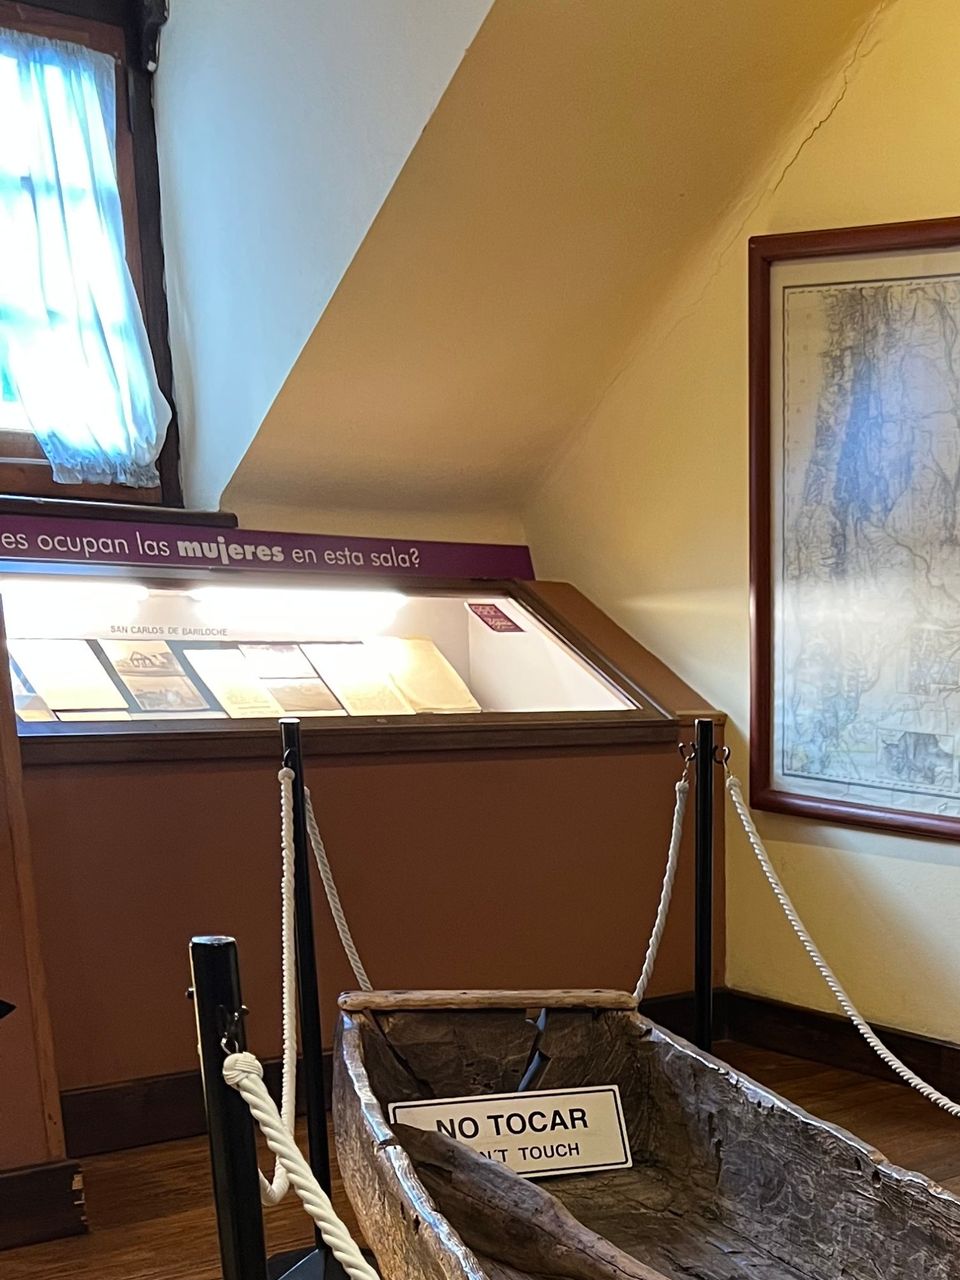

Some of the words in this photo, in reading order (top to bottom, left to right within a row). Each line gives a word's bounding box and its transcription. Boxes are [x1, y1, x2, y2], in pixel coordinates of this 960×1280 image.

[37, 534, 129, 558] ocupan
[135, 531, 170, 556] las
[177, 536, 284, 564] mujeres
[292, 548, 317, 564] en
[324, 547, 364, 566] esta
[371, 546, 420, 568] sala?
[111, 625, 128, 633] SAN
[130, 626, 164, 634] CARLOS
[167, 626, 179, 635] DE
[182, 627, 228, 636] BARILOCHE
[436, 1117, 479, 1139] NO
[486, 1107, 589, 1136] TOCAR
[518, 1142, 580, 1161] TOUCH
